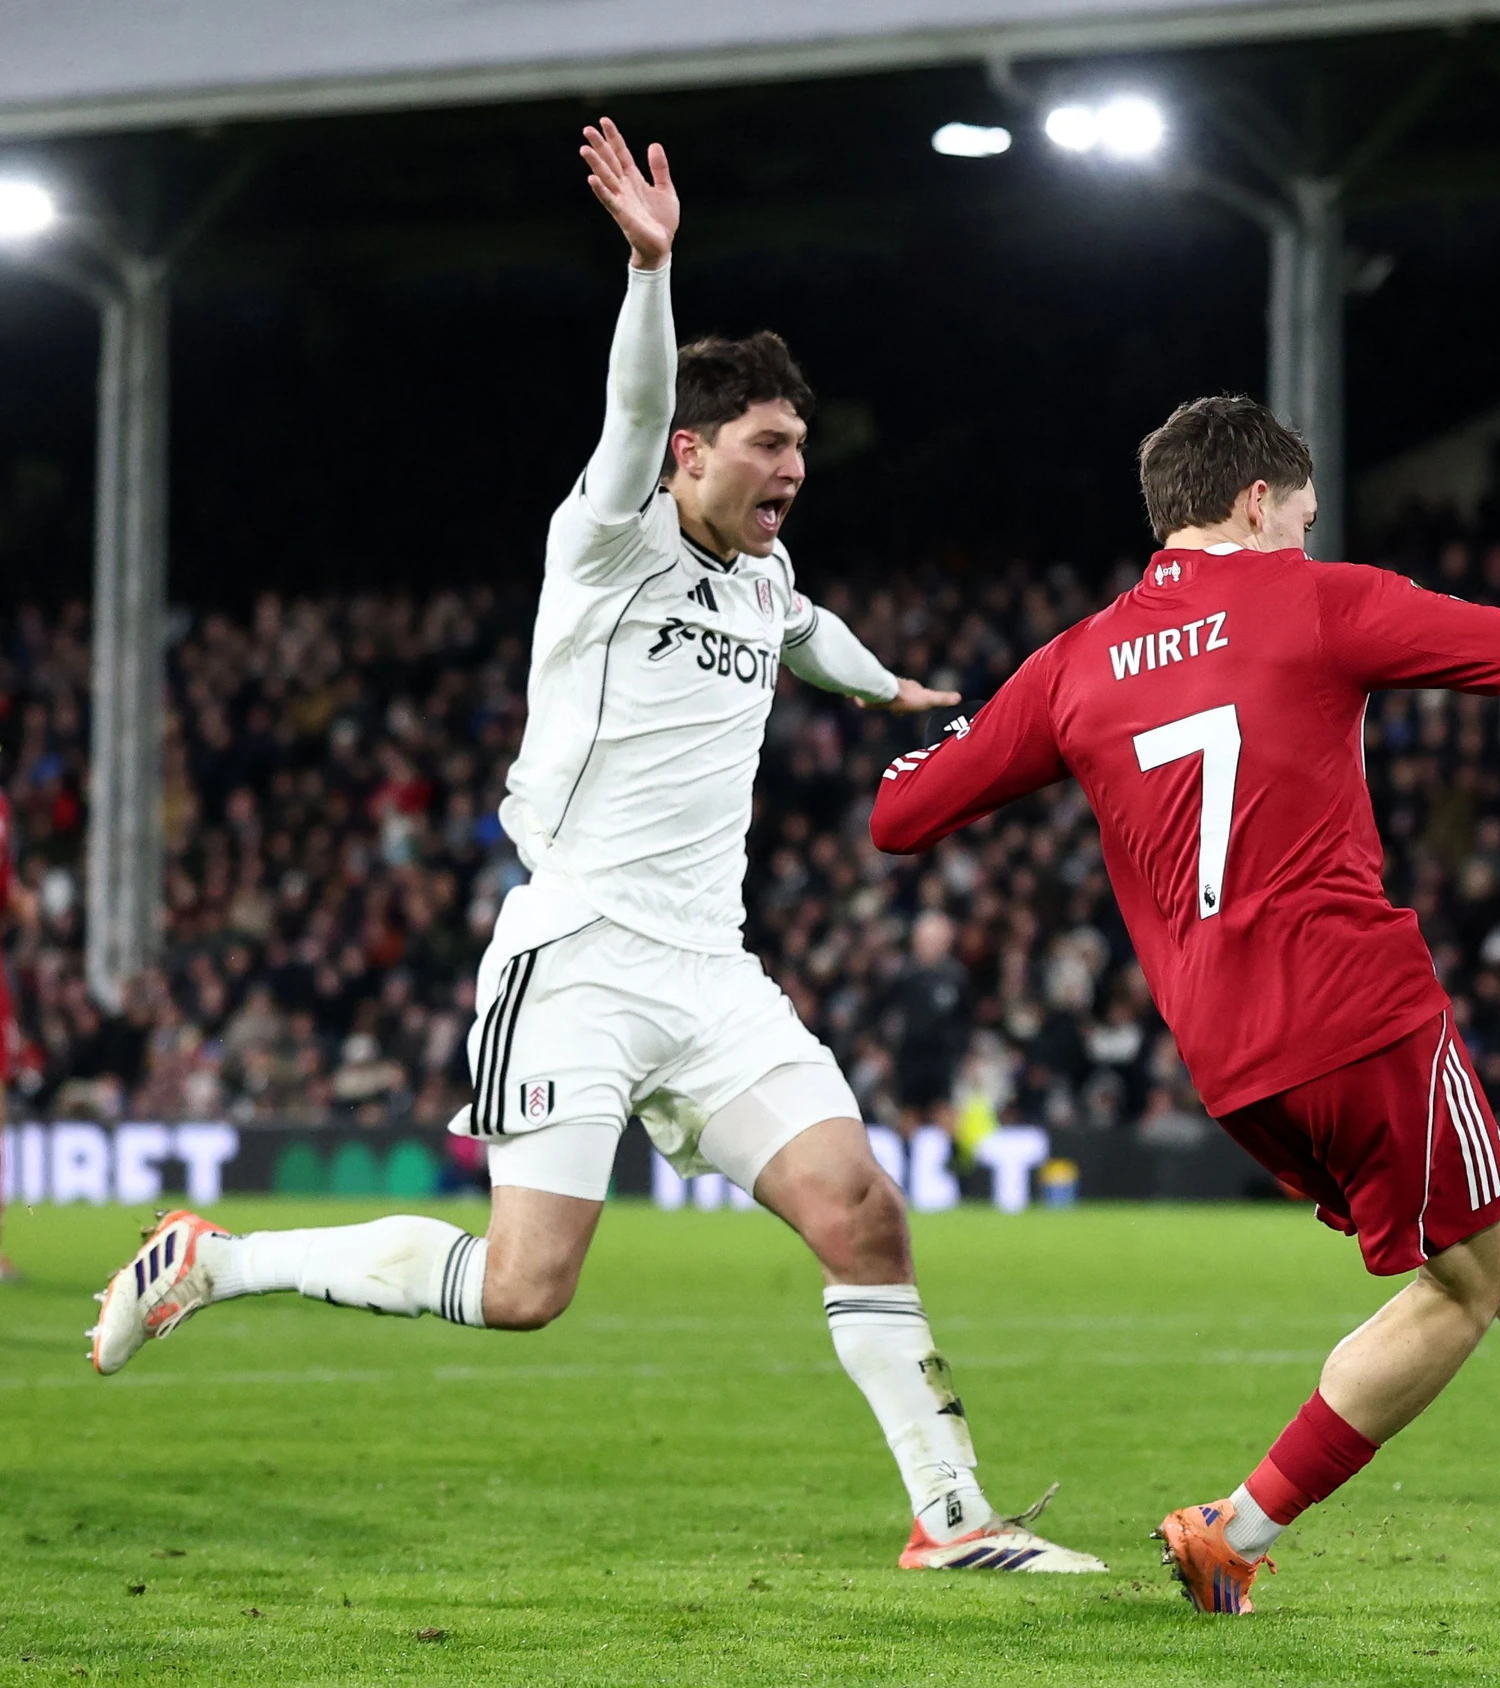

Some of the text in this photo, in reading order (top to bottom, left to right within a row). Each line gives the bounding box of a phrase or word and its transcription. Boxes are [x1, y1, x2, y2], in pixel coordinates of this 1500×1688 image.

[1109, 611, 1229, 681] WIRTZ
[1132, 703, 1242, 921] 7
[0, 1121, 240, 1207] IBET
